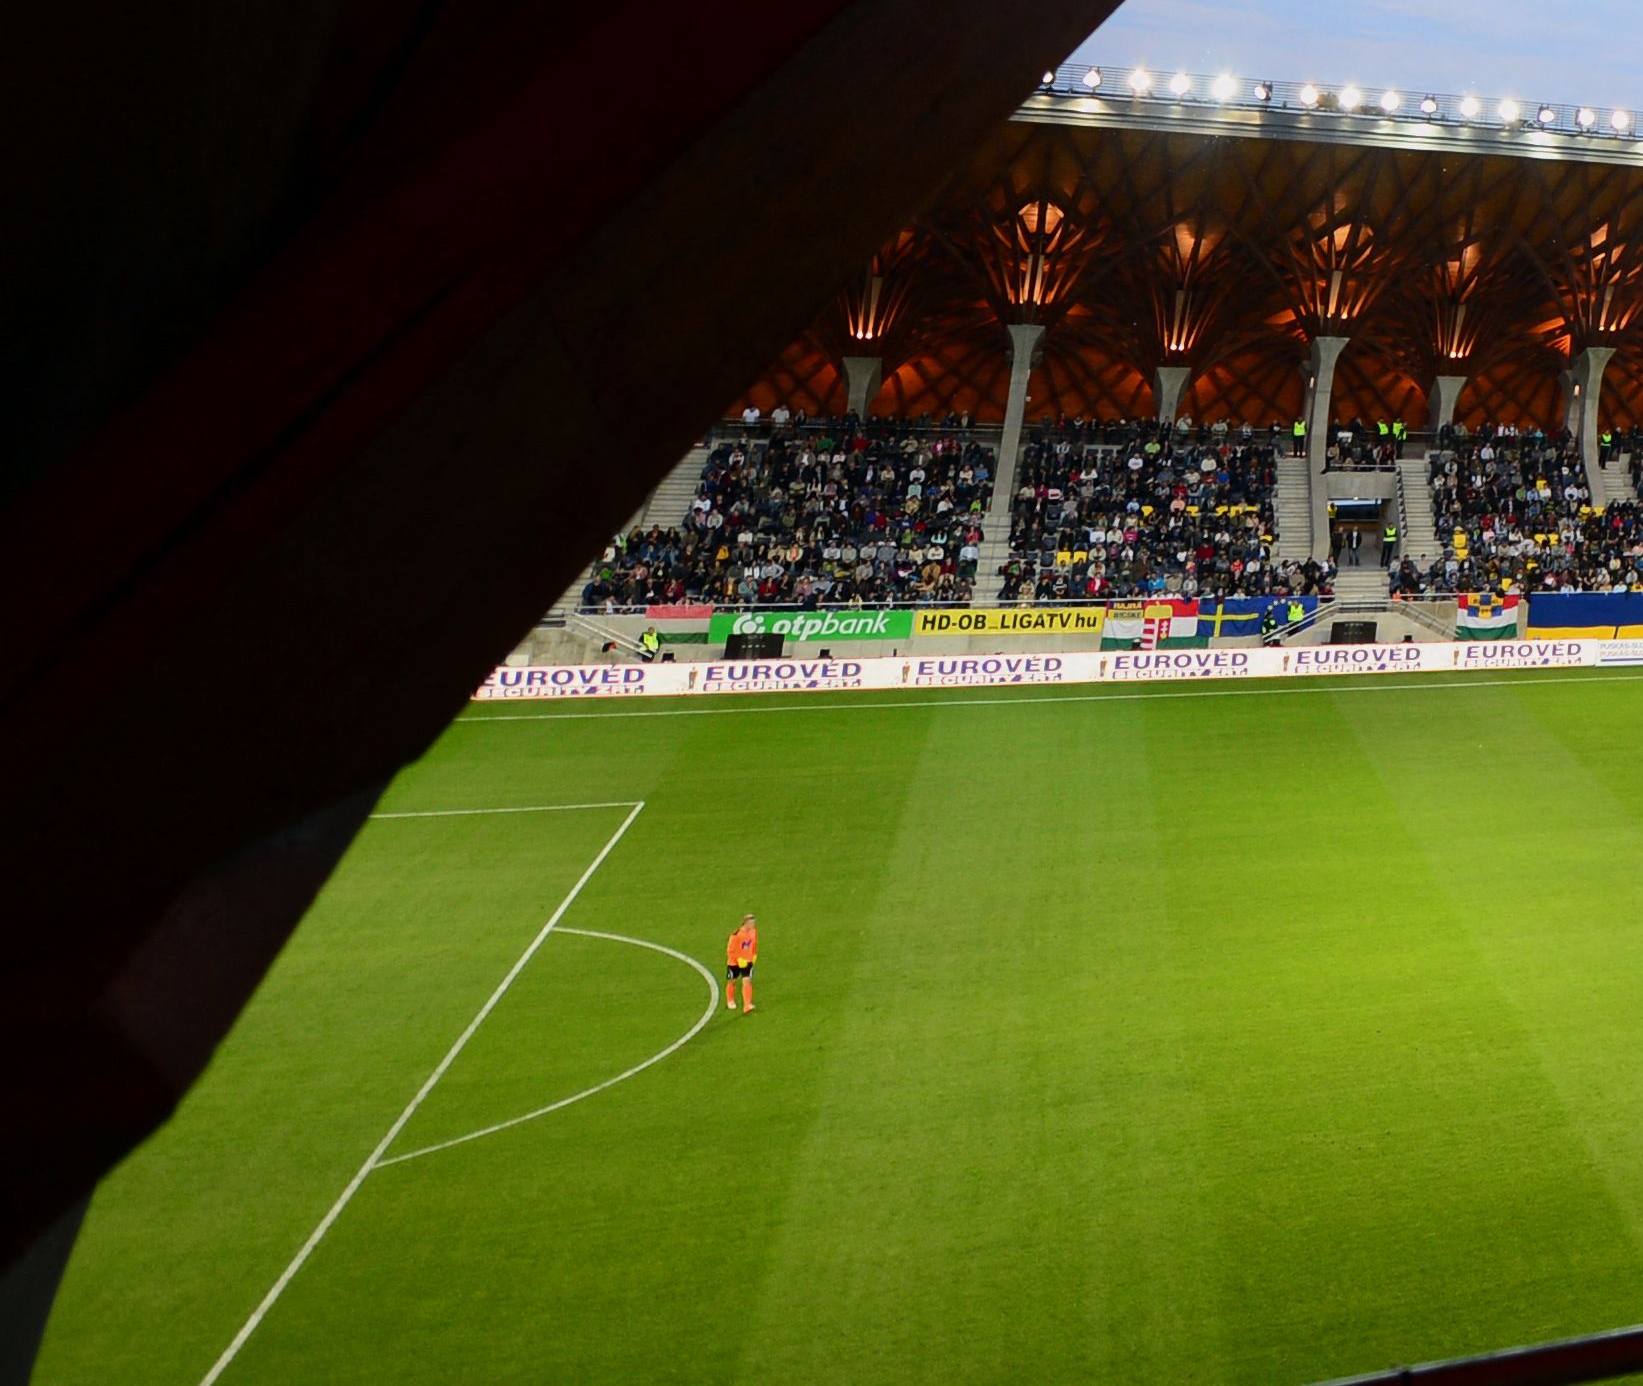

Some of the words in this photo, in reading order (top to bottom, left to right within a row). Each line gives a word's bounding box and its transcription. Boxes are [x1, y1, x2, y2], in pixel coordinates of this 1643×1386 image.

[772, 612, 892, 641] otpbank
[1115, 651, 1248, 670] EUROVÉD
[1297, 645, 1421, 664] EUROVÉD
[1466, 642, 1582, 660] EUROVÉD
[705, 658, 862, 681] EUROVÉD
[918, 655, 1063, 675] EUROVÉD
